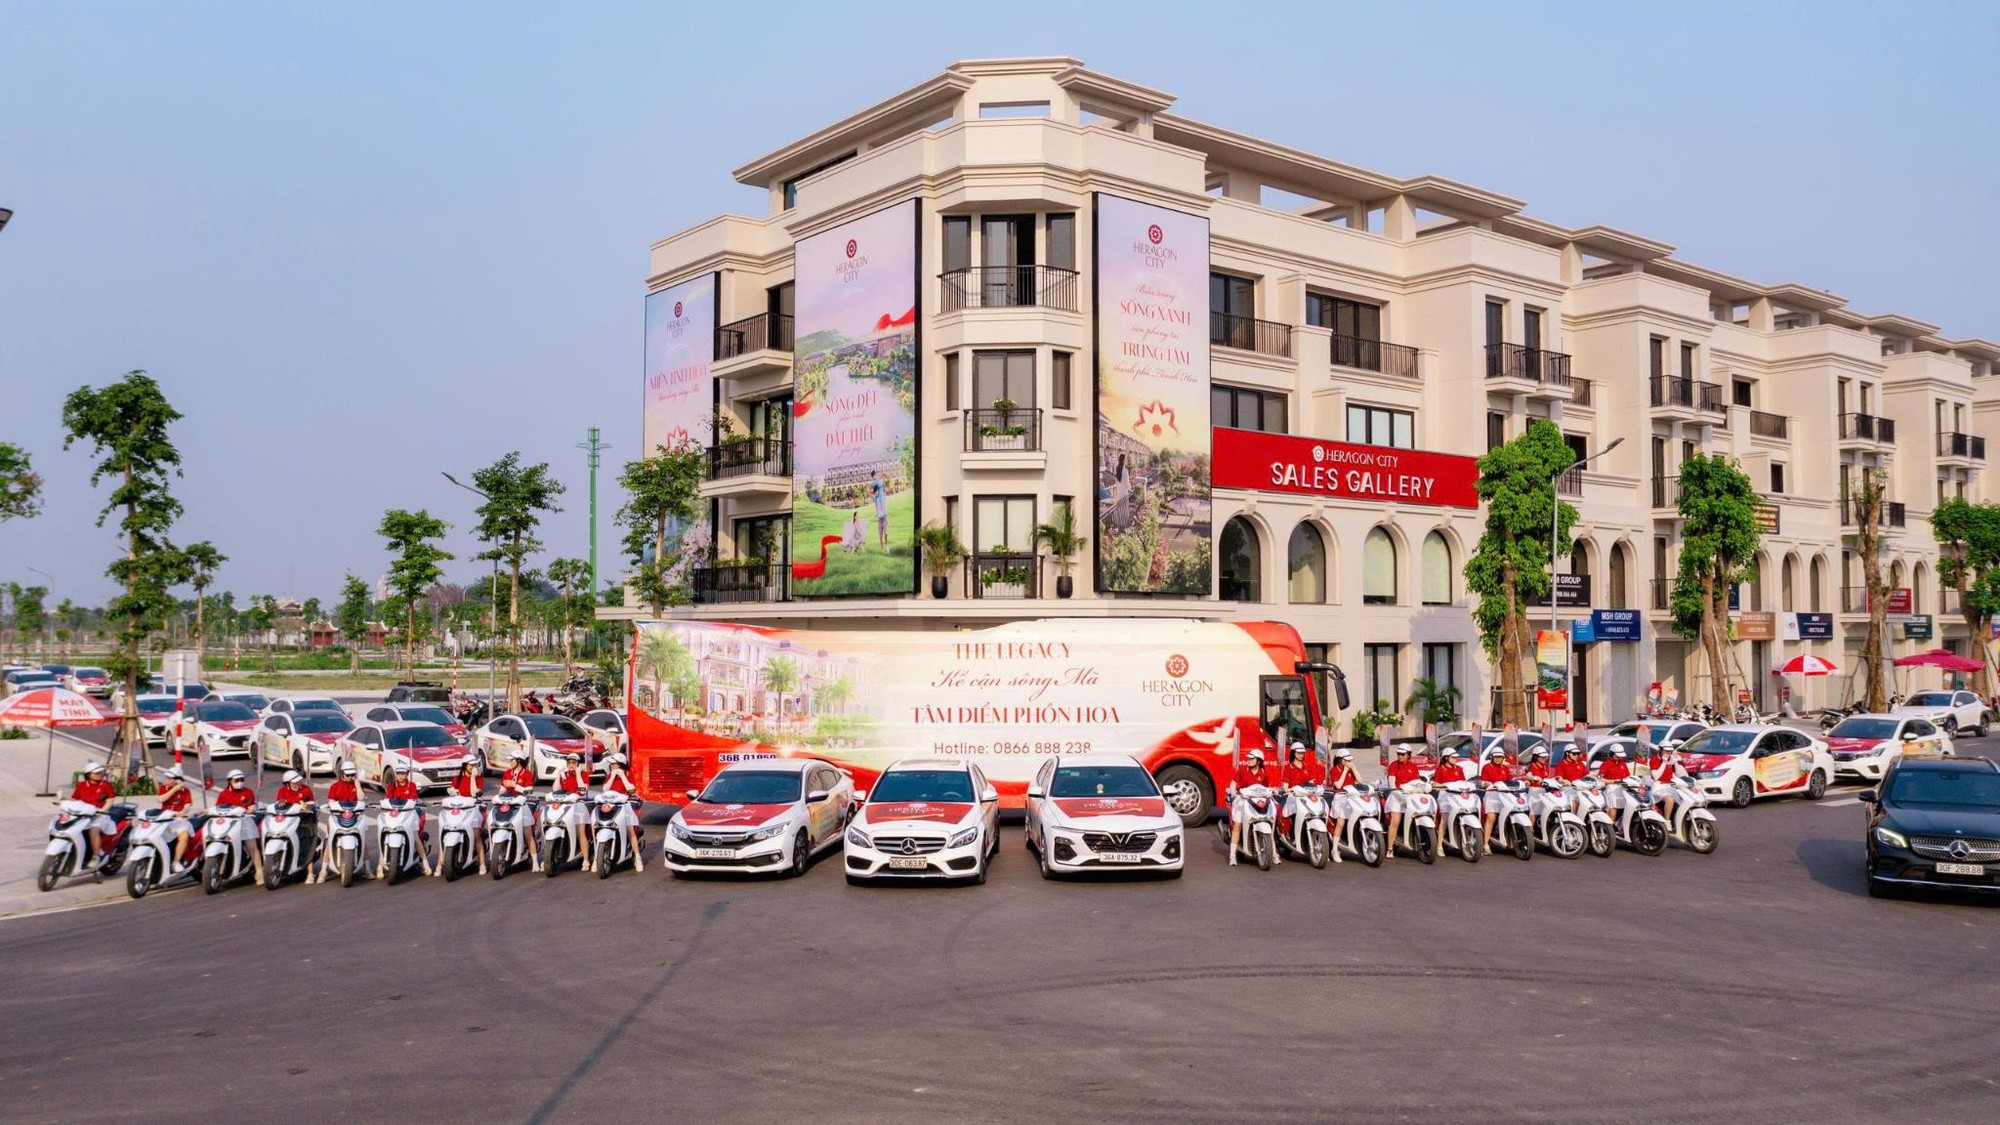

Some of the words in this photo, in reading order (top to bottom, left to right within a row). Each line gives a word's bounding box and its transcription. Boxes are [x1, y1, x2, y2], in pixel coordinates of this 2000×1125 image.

[1133, 241, 1178, 261] HERAGON
[1145, 256, 1166, 269] CITY
[1121, 340, 1163, 361] TRUNG
[1325, 449, 1374, 465] HERAGON
[1376, 454, 1398, 468] CITY
[1271, 462, 1339, 491] SALES
[1346, 470, 1435, 499] GALLERY
[1560, 576, 1581, 584] GROUP
[1614, 612, 1633, 620] GROUP
[952, 642, 992, 659] THE
[996, 642, 1071, 659] LEGACY
[1008, 672, 1053, 702] sông
[1053, 667, 1099, 687] Mã
[1142, 680, 1213, 693] HERAGON
[1161, 693, 1194, 707] CITY
[911, 703, 952, 724] TÂM
[1077, 706, 1120, 723] HOA
[934, 742, 989, 754] Hotline:
[993, 742, 1030, 754] 0866
[1035, 742, 1061, 754] 888
[1065, 742, 1091, 754] 238
[720, 754, 740, 762] 36B
